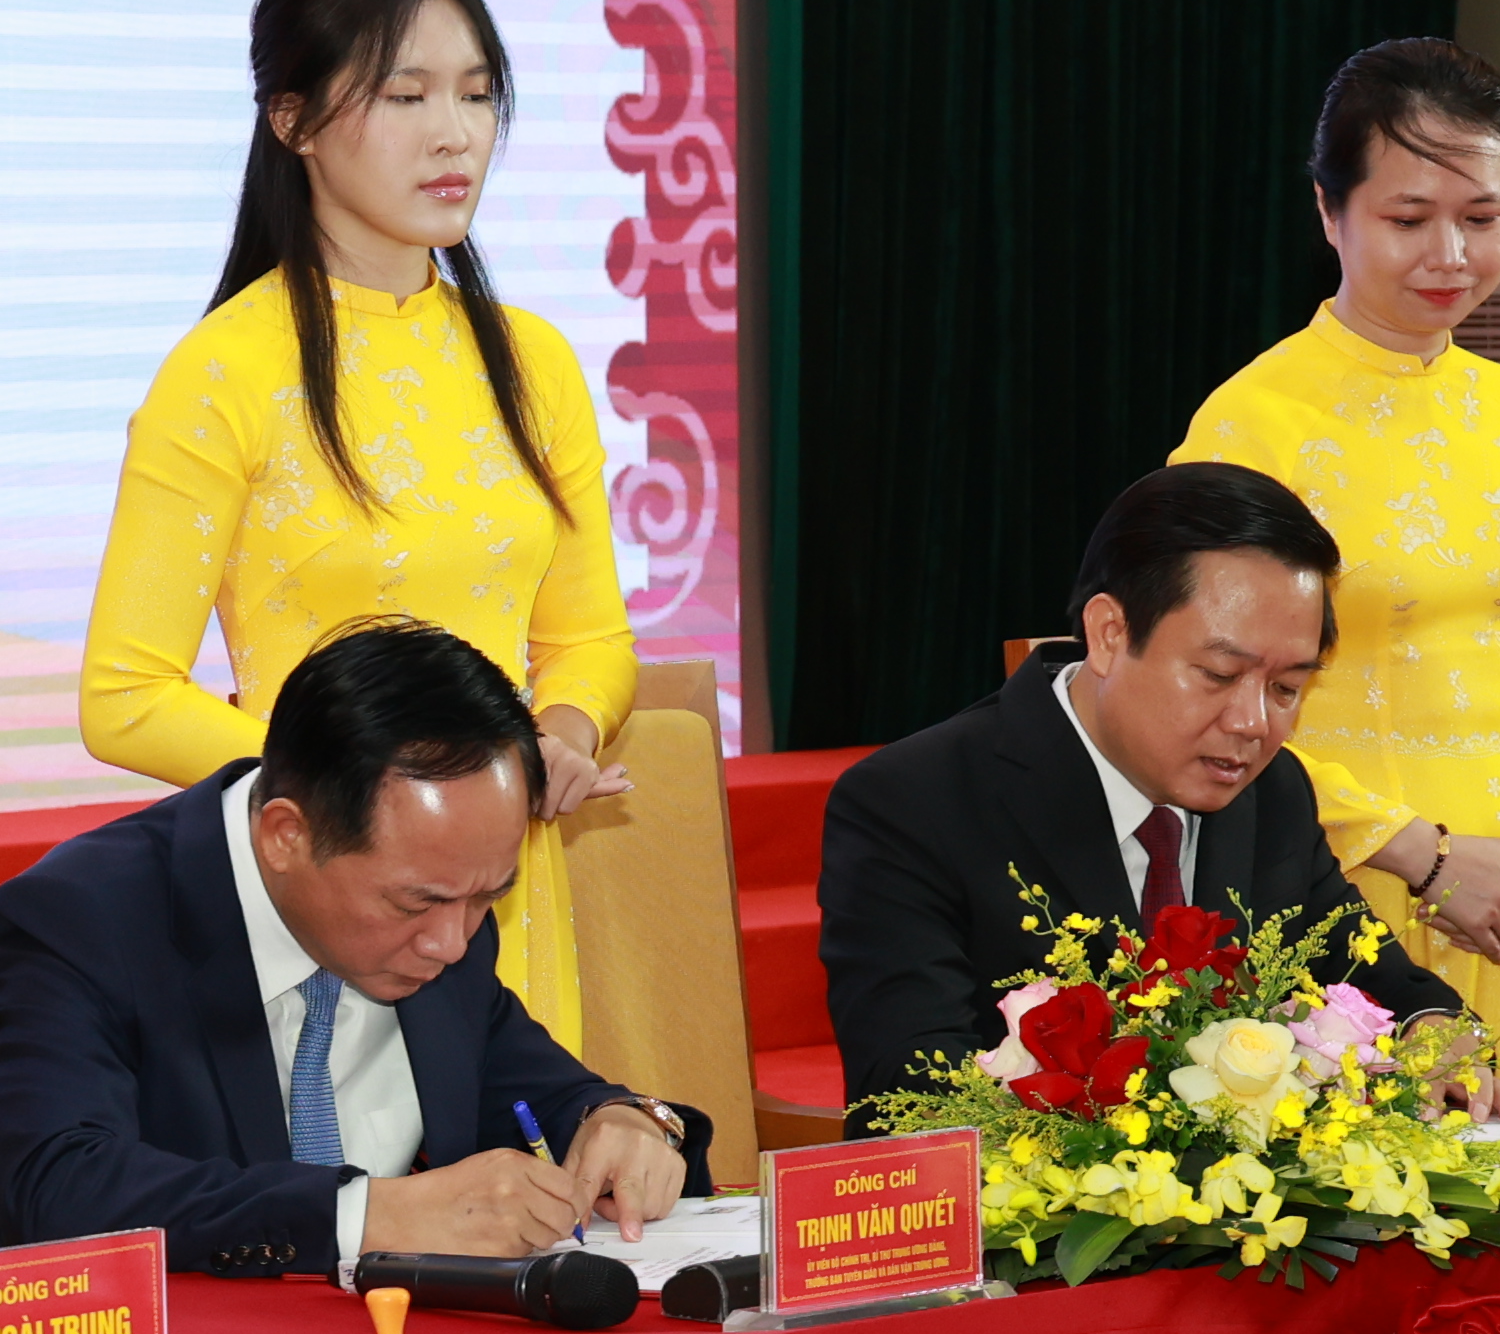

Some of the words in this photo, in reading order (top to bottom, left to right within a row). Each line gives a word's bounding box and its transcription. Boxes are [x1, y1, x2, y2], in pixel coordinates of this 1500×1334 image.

[834, 1168, 884, 1197] ĐỒNG
[889, 1163, 917, 1188] CHÍ
[797, 1213, 852, 1252] TRỊNH
[857, 1202, 896, 1239] VĂN
[900, 1188, 957, 1235] QUYẾT
[54, 1267, 90, 1296] CHÍ
